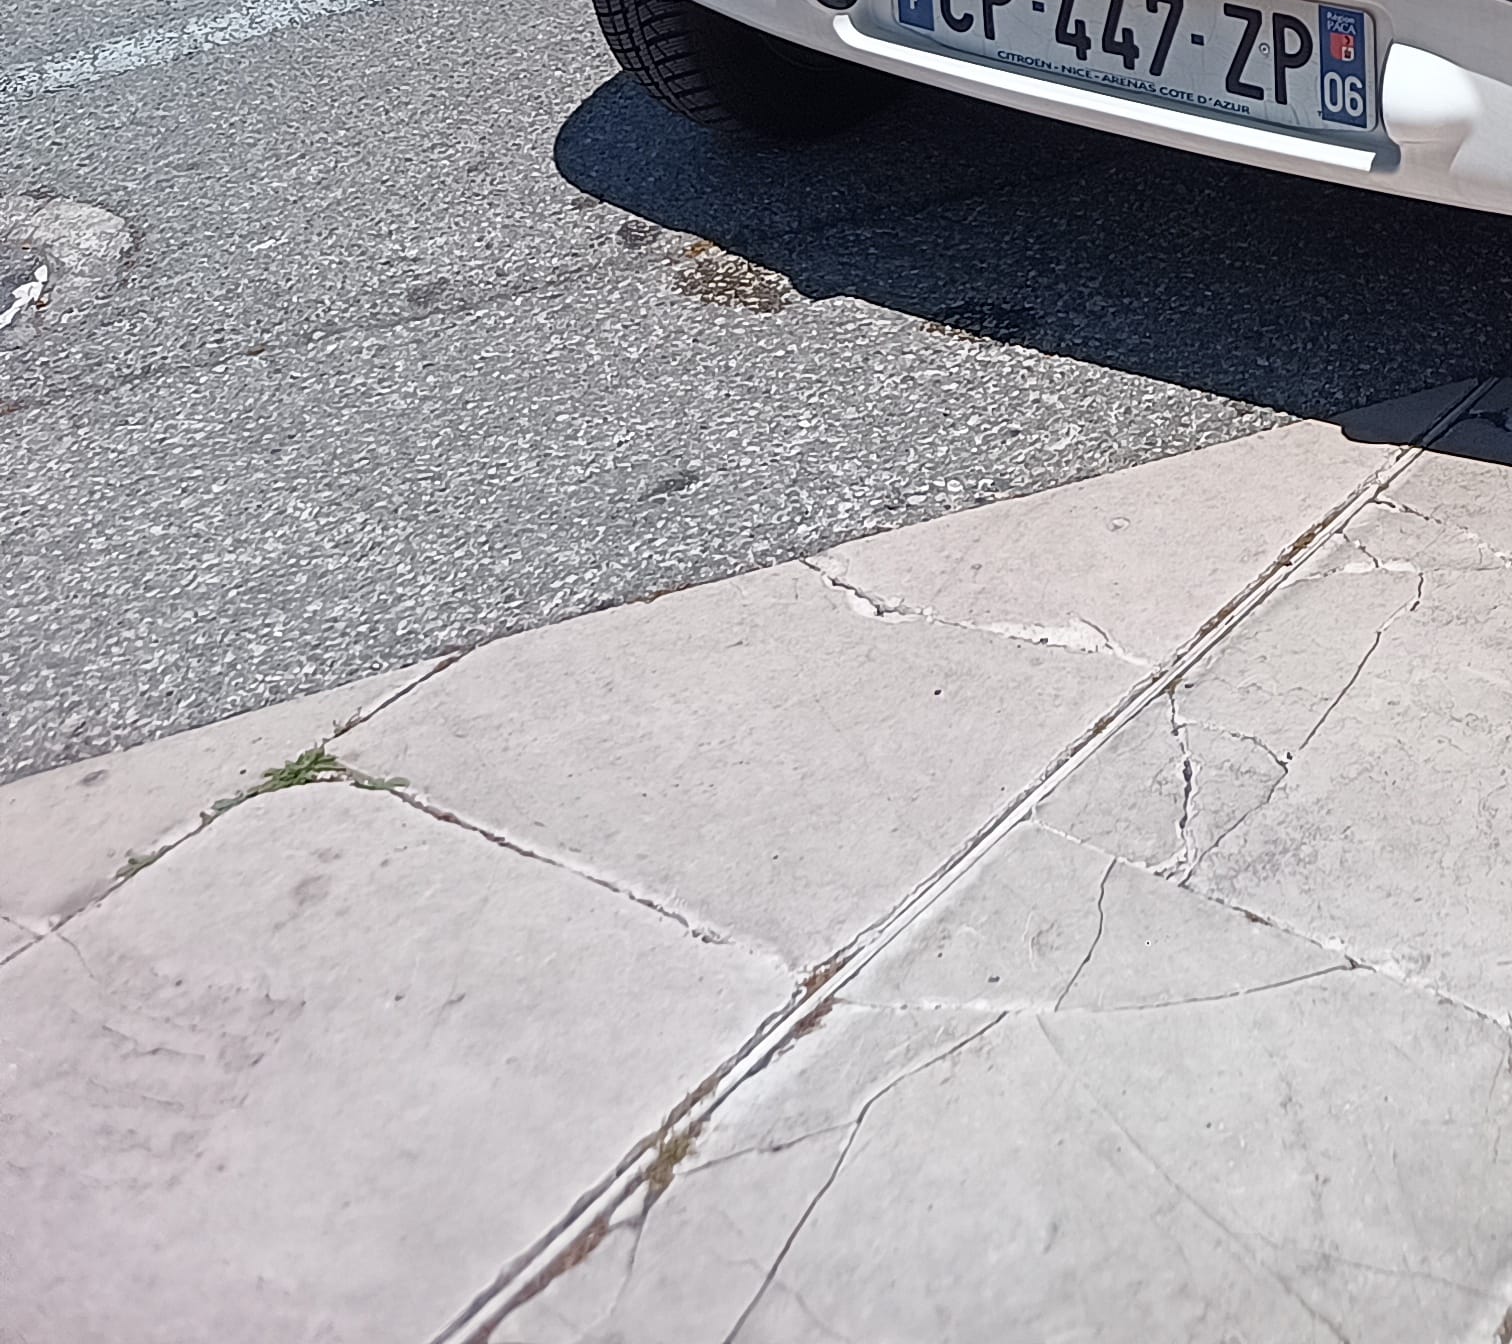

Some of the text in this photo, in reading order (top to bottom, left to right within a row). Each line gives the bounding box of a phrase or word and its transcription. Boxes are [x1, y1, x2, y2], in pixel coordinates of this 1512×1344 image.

[1327, 20, 1357, 36] PACA
[1061, 64, 1093, 80] NICE
[1101, 74, 1157, 92] ARENAS
[1159, 86, 1194, 102] COTE
[1197, 95, 1250, 115] D'AZUR
[1323, 71, 1367, 117] 06
